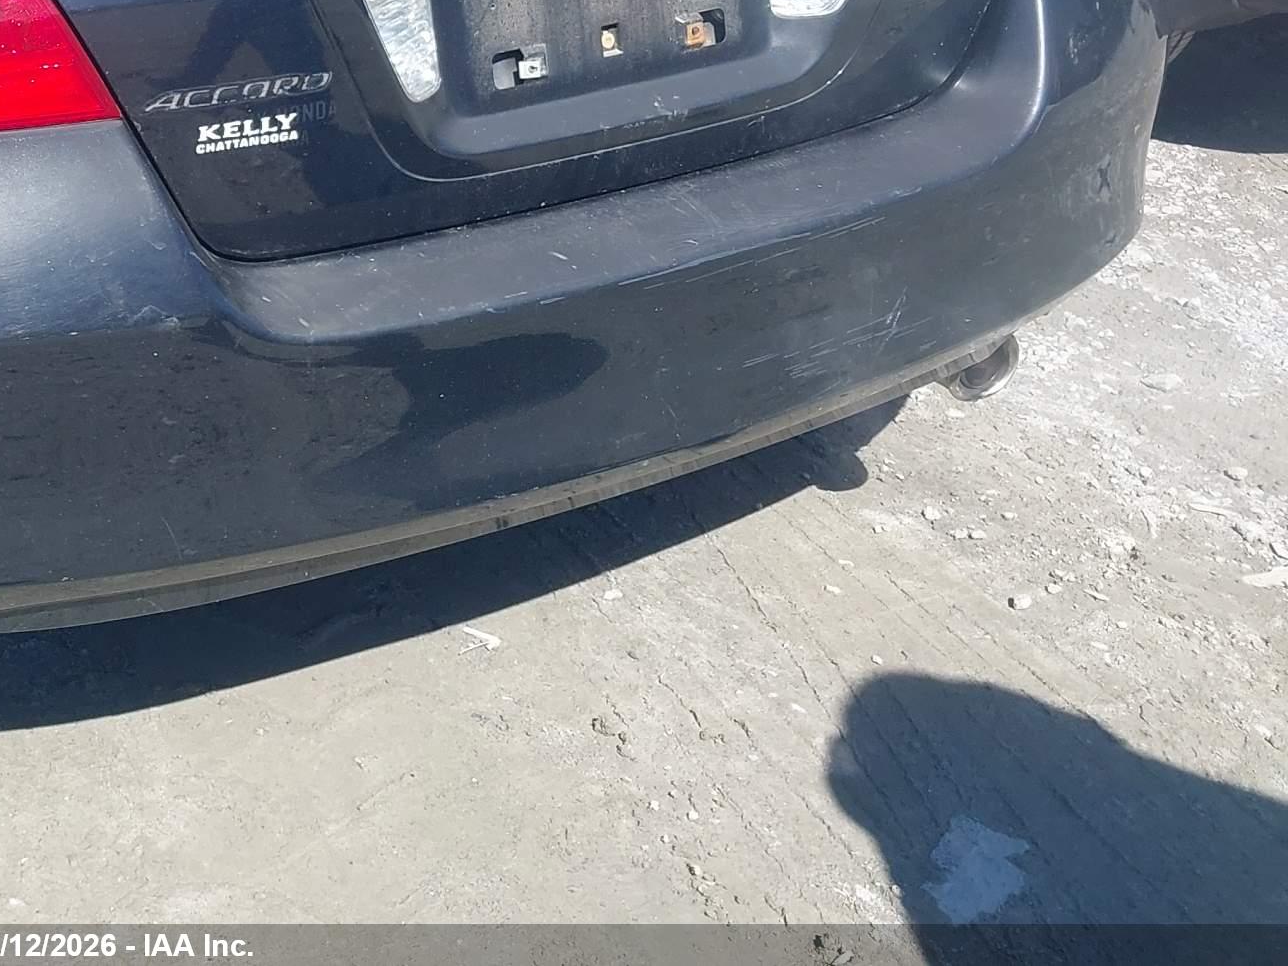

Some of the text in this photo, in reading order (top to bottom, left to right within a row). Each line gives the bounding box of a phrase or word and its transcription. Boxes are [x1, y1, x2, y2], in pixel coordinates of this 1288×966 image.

[143, 71, 333, 113] ACCORD
[195, 130, 299, 155] CHATTANOOGA
[197, 112, 298, 143] KELLY
